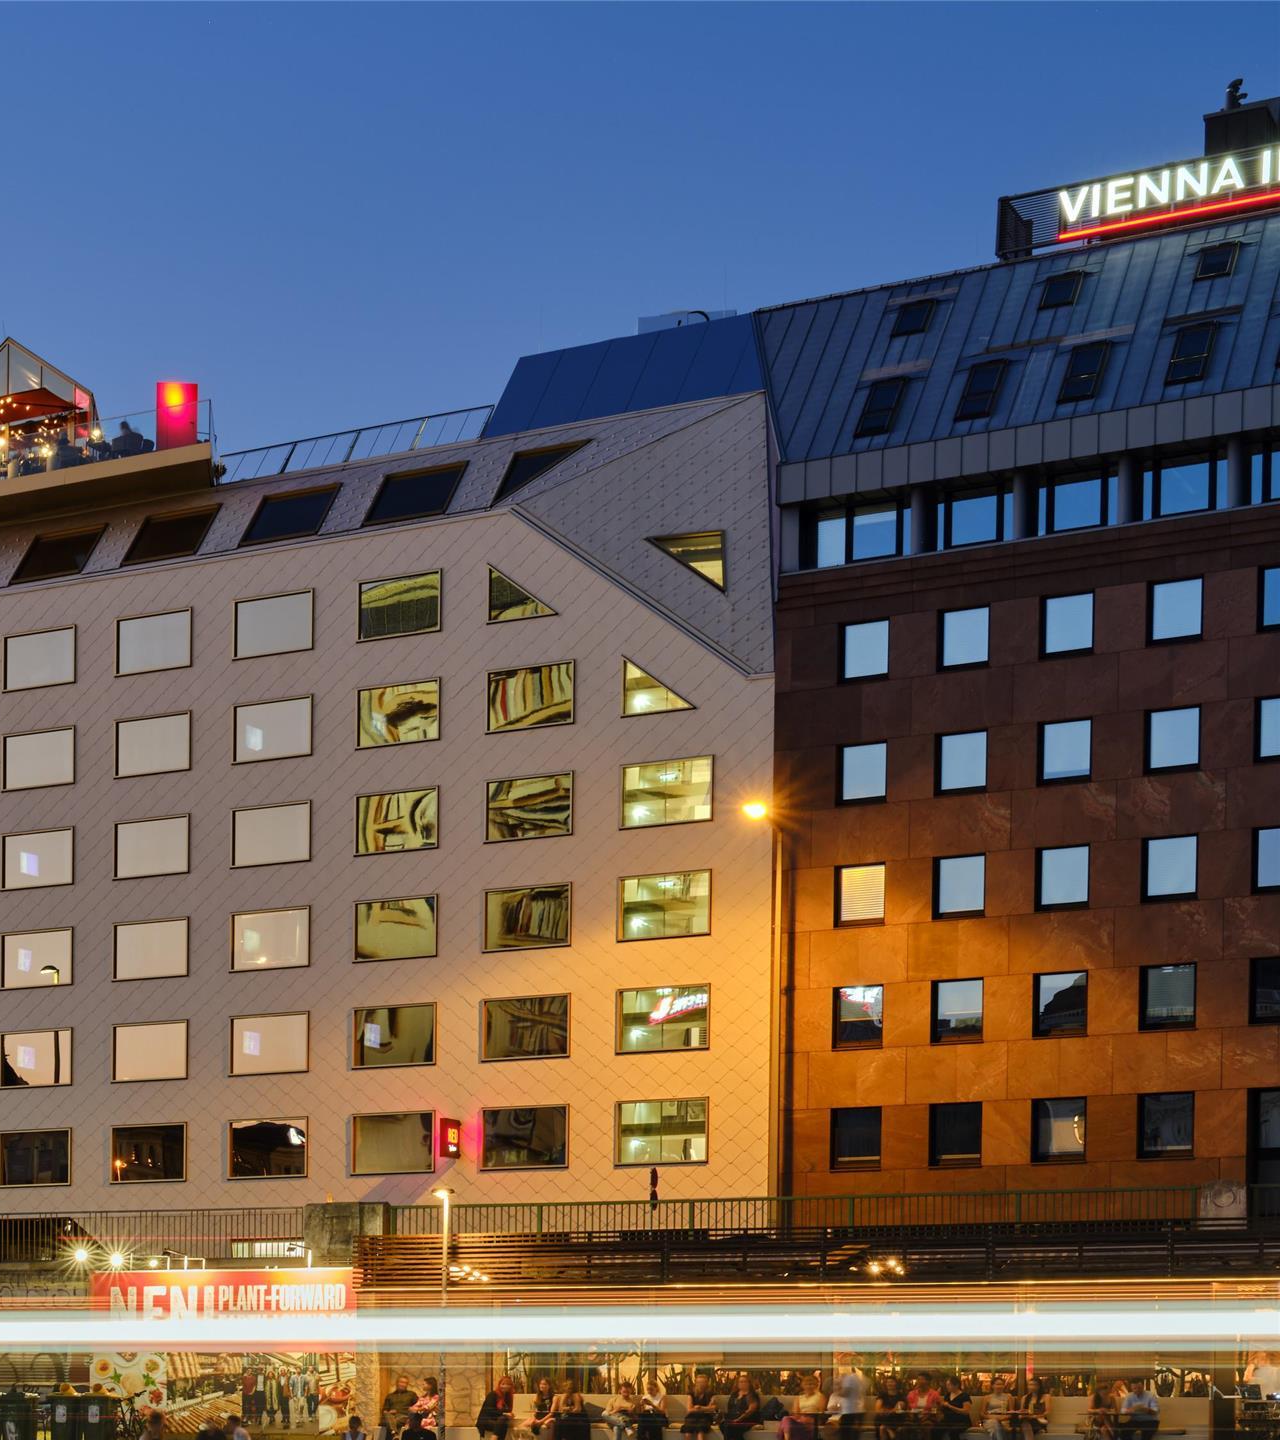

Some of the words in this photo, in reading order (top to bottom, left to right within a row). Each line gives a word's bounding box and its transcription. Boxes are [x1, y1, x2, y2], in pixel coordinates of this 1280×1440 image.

[1059, 157, 1245, 222] VIENNA
[1261, 146, 1280, 184] I
[218, 1283, 347, 1311] PLANT-FORWARD
